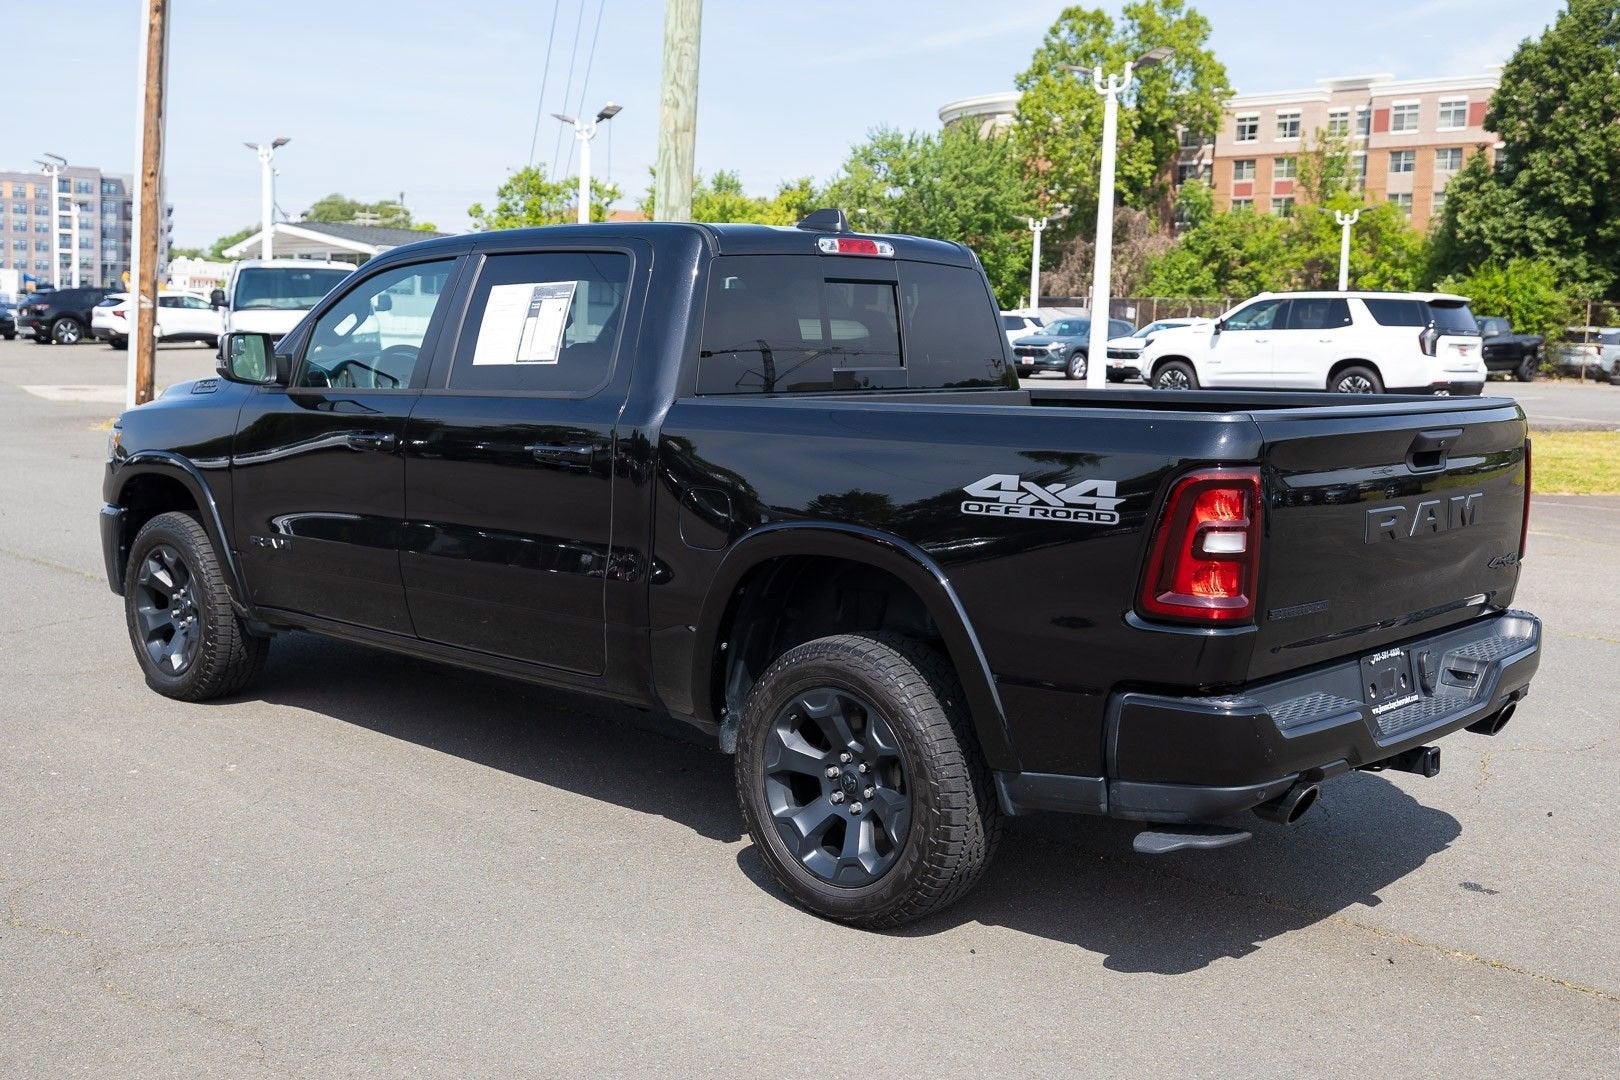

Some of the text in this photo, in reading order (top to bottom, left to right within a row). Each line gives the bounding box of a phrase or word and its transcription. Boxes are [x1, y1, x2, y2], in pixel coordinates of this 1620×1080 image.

[963, 503, 1117, 522] OFF ROAD
[1364, 492, 1484, 544] RAM
